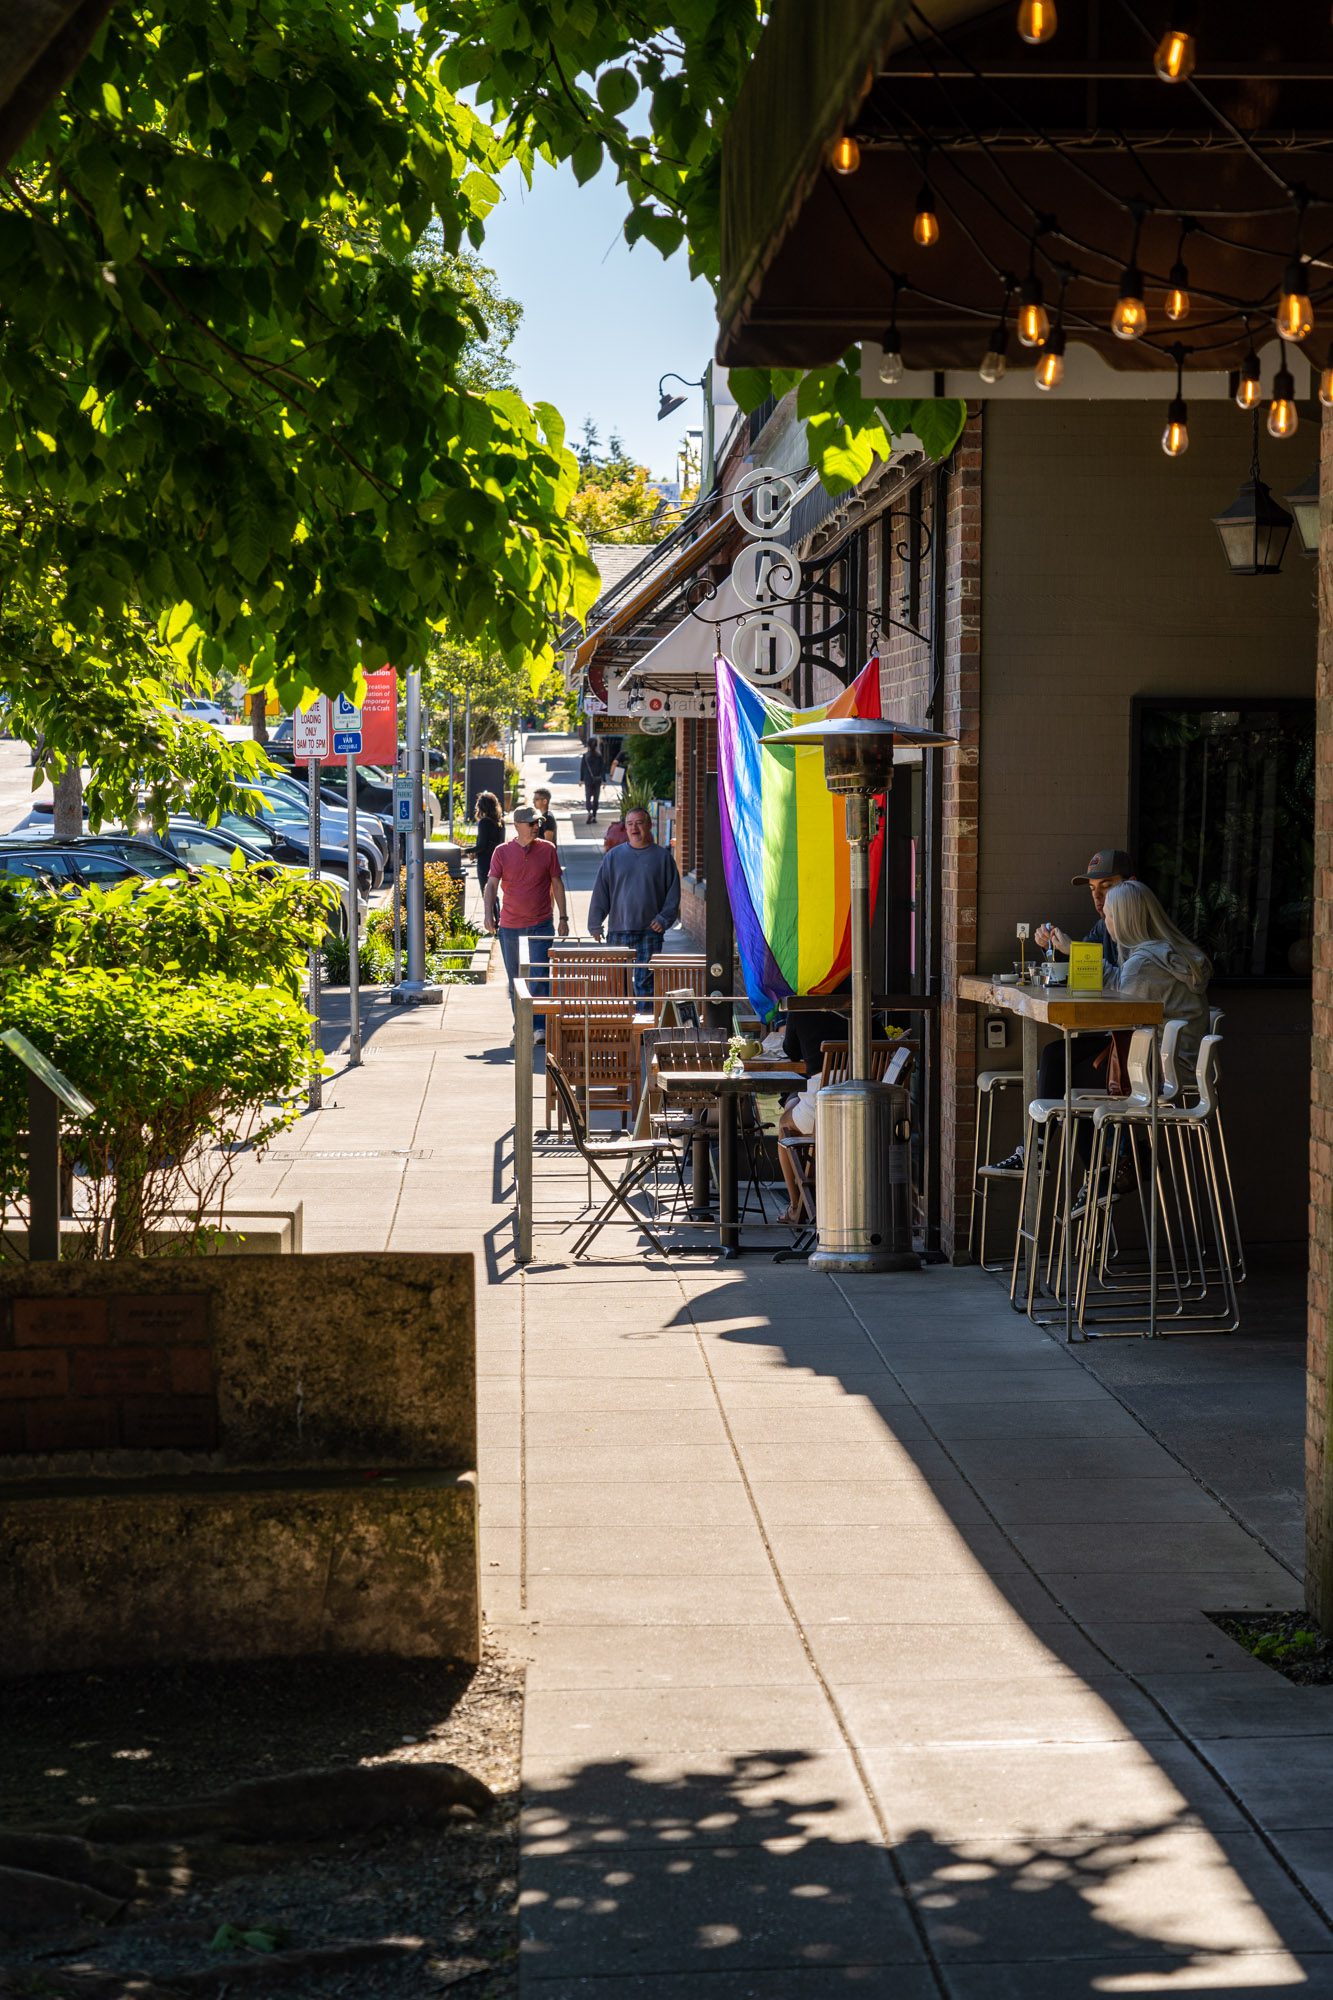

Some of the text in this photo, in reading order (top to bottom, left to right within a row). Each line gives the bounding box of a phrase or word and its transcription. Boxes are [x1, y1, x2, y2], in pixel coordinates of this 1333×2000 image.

[364, 698, 391, 706] mporary
[666, 694, 704, 711] raft
[301, 714, 322, 724] LOADING
[304, 726, 317, 736] ONLY
[297, 739, 326, 749] 9AM TO 5PM
[342, 736, 353, 744] VAN
